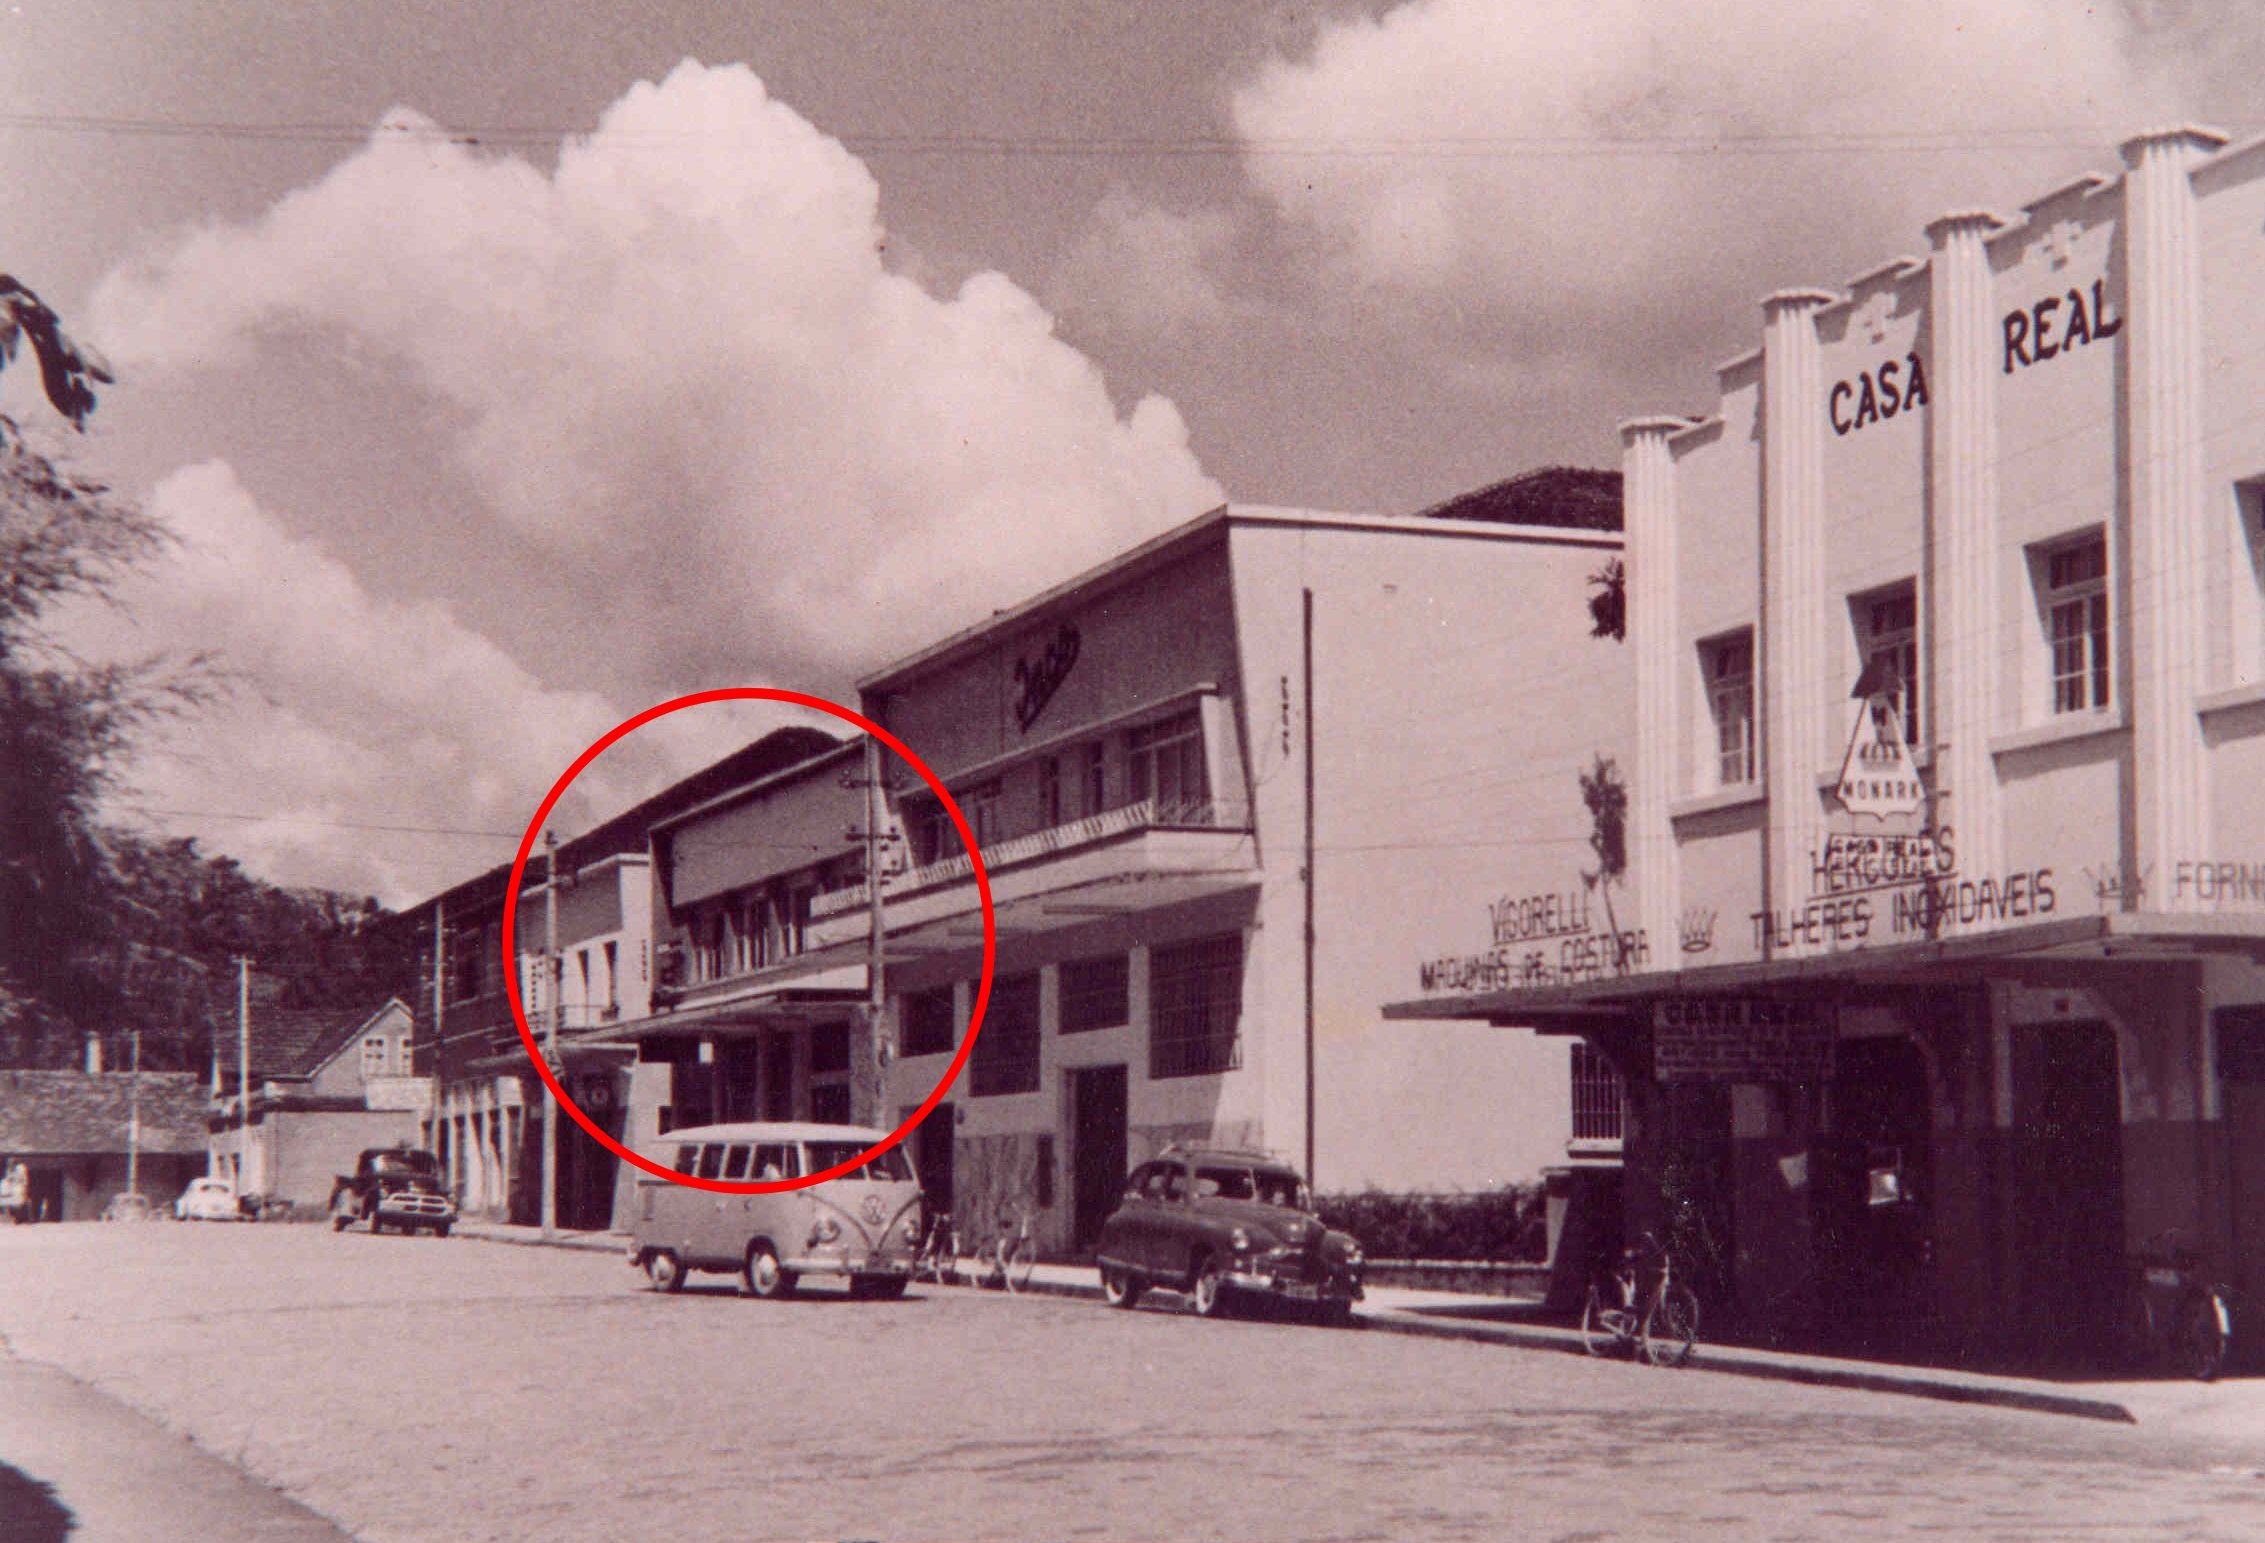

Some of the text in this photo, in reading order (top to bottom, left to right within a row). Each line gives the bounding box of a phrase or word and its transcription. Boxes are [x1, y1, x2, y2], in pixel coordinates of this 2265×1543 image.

[1830, 278, 2122, 437] CASA REAL
[1842, 780, 1919, 800] MONARK
[1810, 826, 1955, 892] HERCULES
[2175, 860, 2265, 900] FORN
[1487, 889, 1591, 942] VIGORELLI
